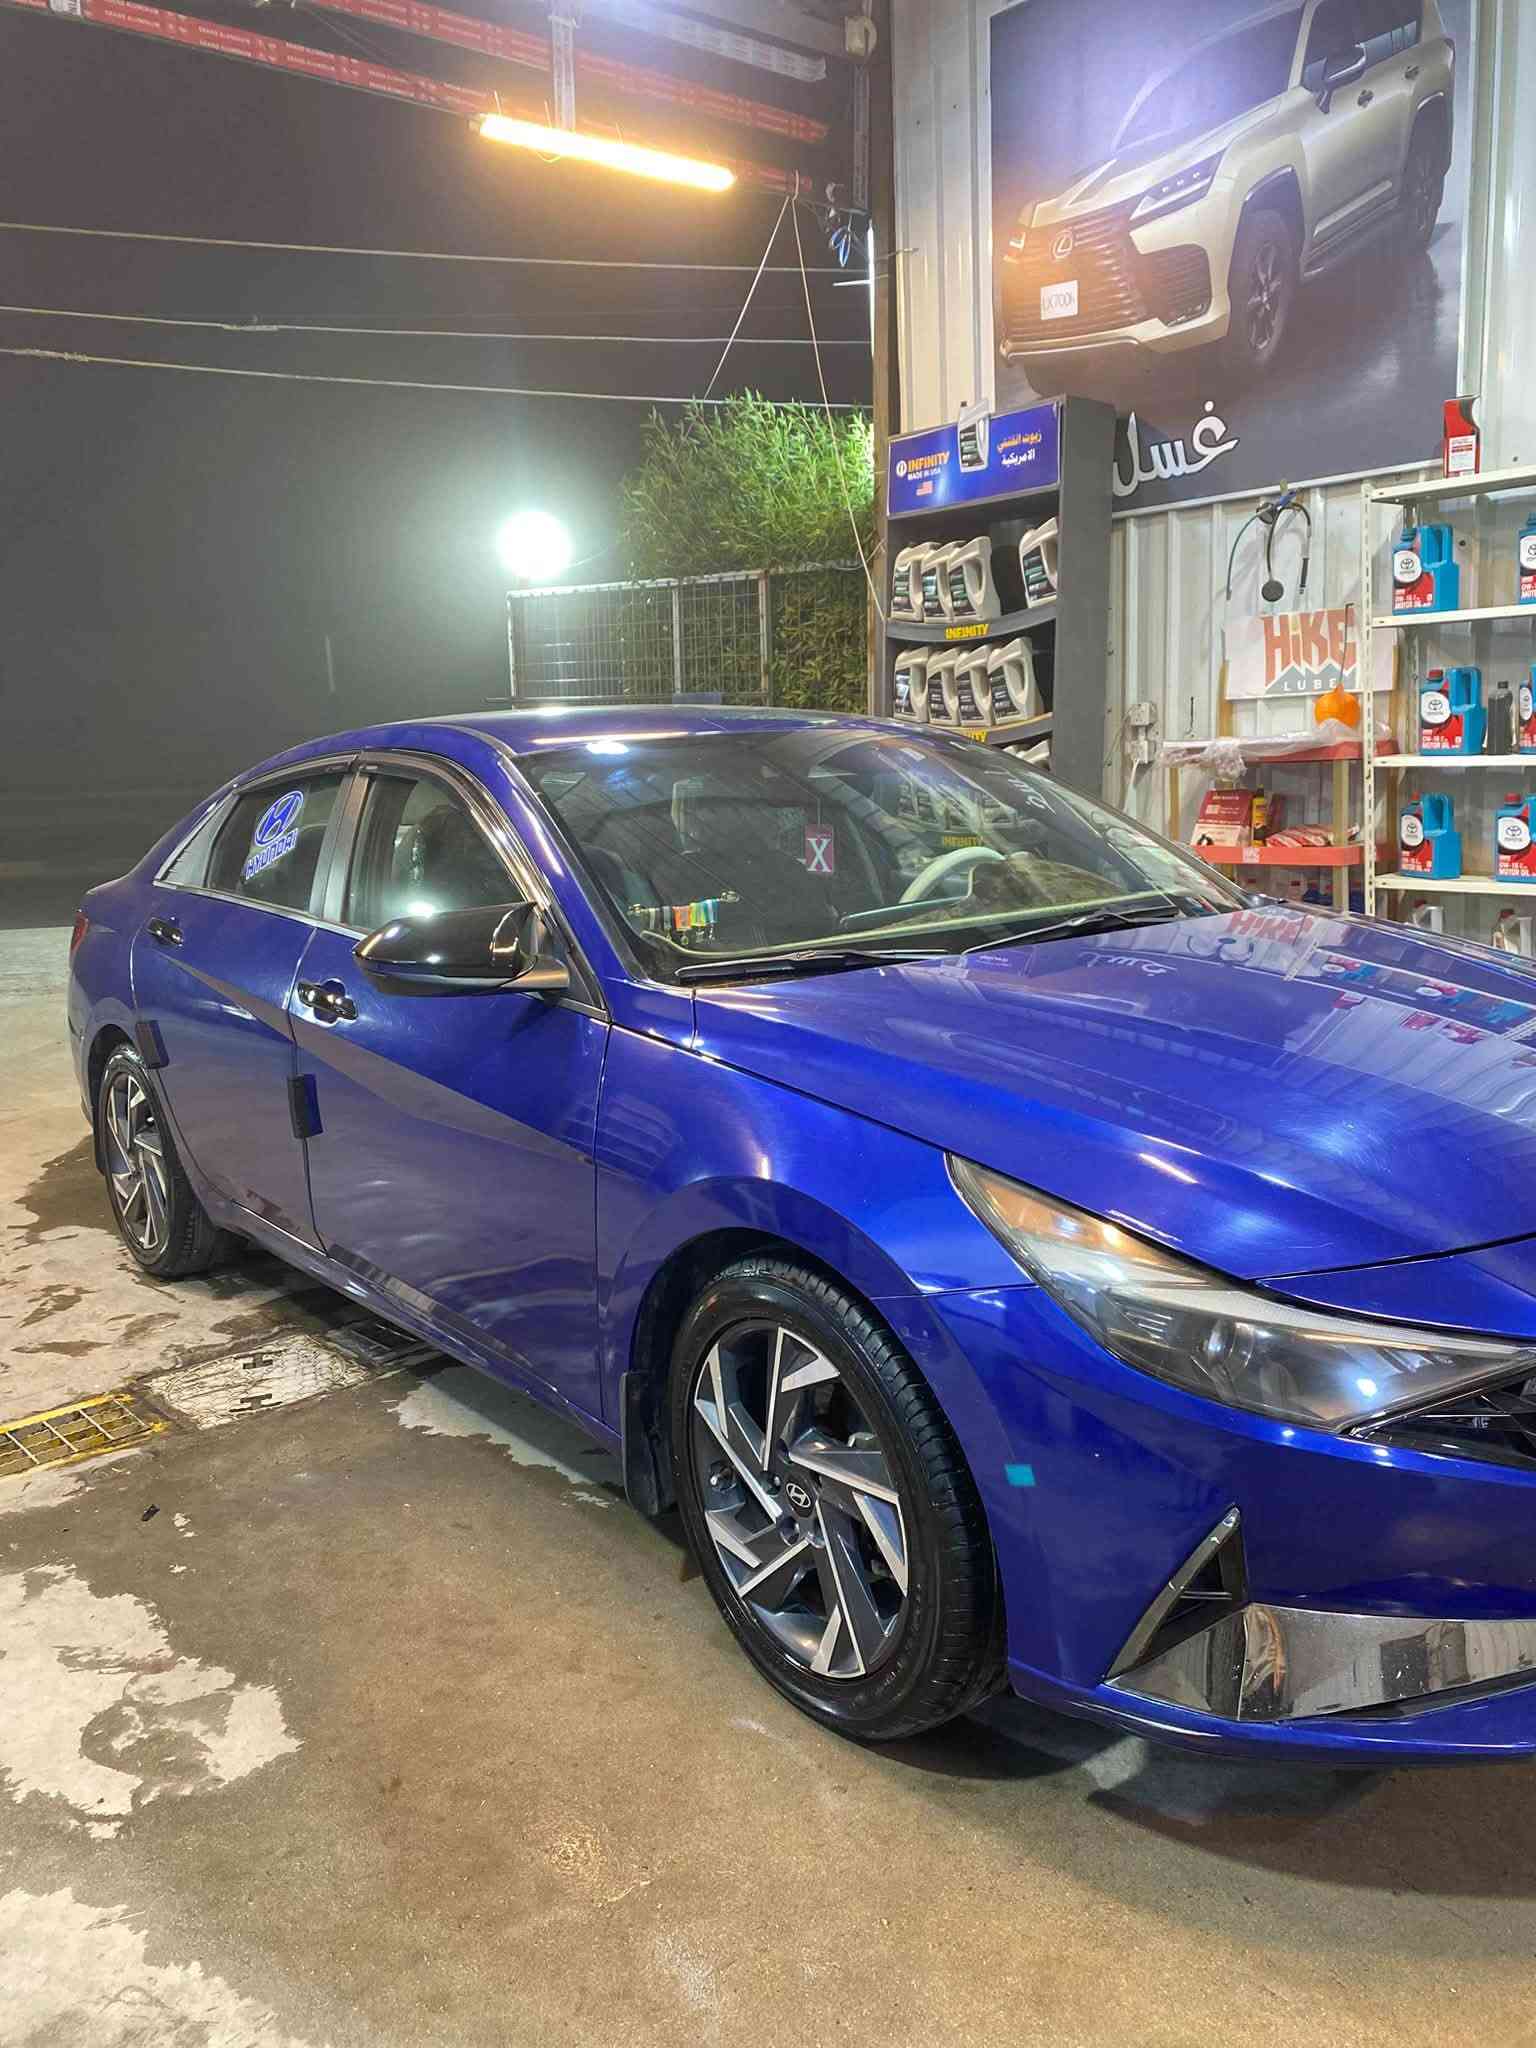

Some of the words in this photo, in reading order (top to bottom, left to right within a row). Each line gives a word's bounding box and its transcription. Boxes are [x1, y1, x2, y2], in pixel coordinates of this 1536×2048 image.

[908, 451, 950, 473] INFINITY
[1112, 400, 1240, 497] غسل
[945, 623, 989, 640] INFINITY
[1283, 678, 1338, 692] LUBE
[245, 828, 299, 881] HYUNDAI
[807, 838, 832, 872] X
